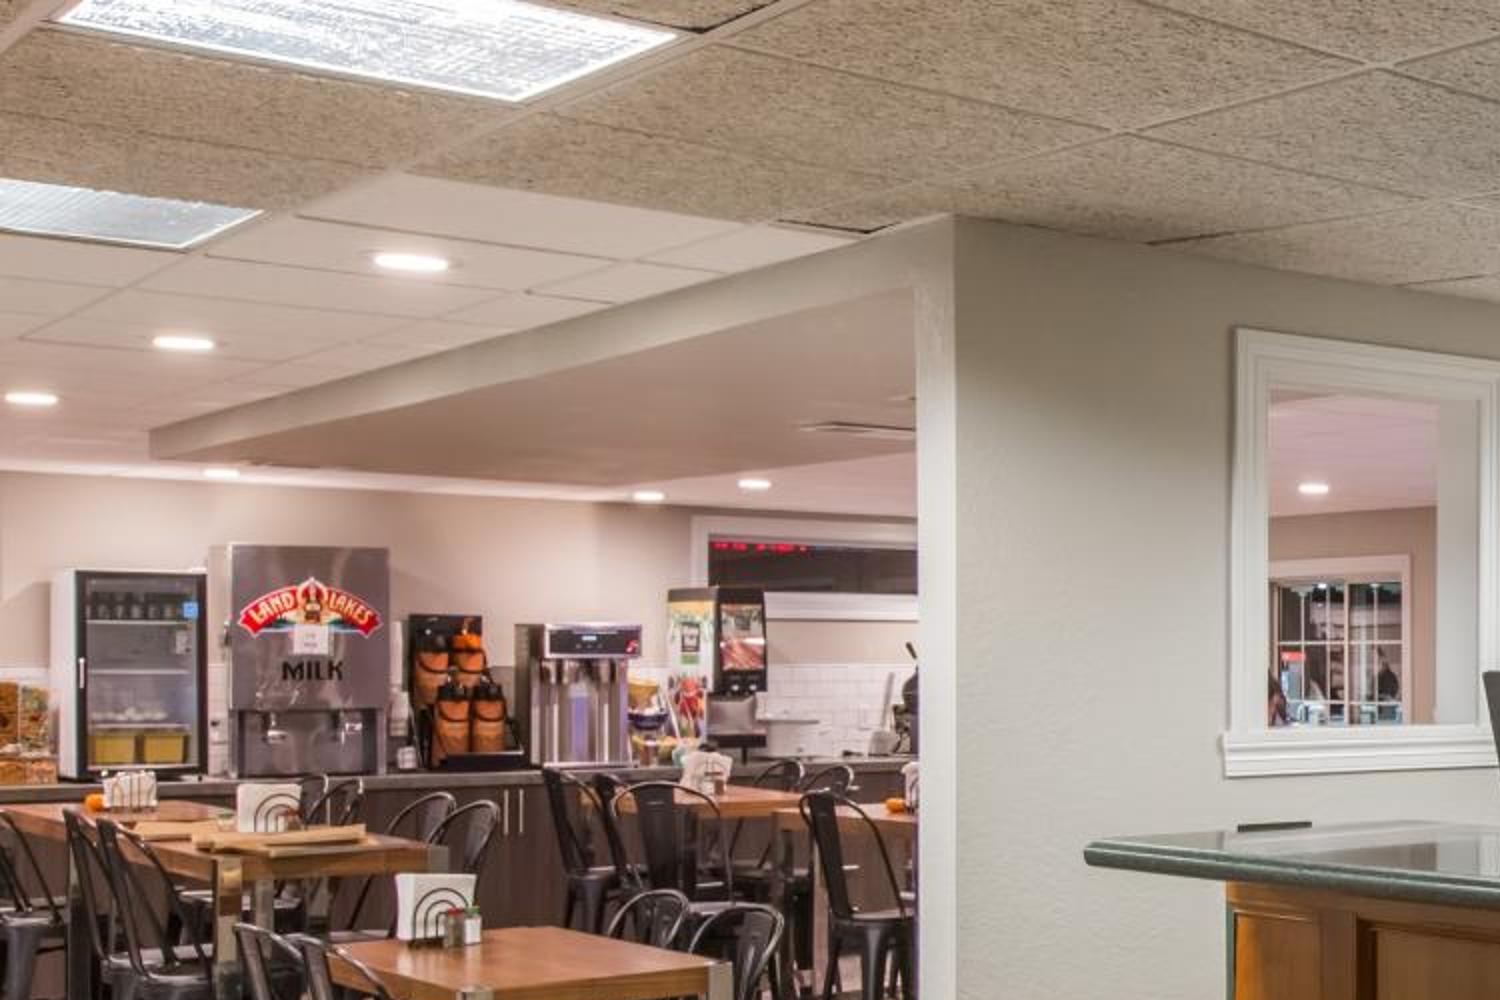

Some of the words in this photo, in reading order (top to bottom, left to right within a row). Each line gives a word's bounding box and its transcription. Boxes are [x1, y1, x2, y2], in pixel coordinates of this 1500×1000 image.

[248, 591, 296, 624] LAND
[329, 592, 373, 625] LAKES
[281, 661, 344, 681] MILK
